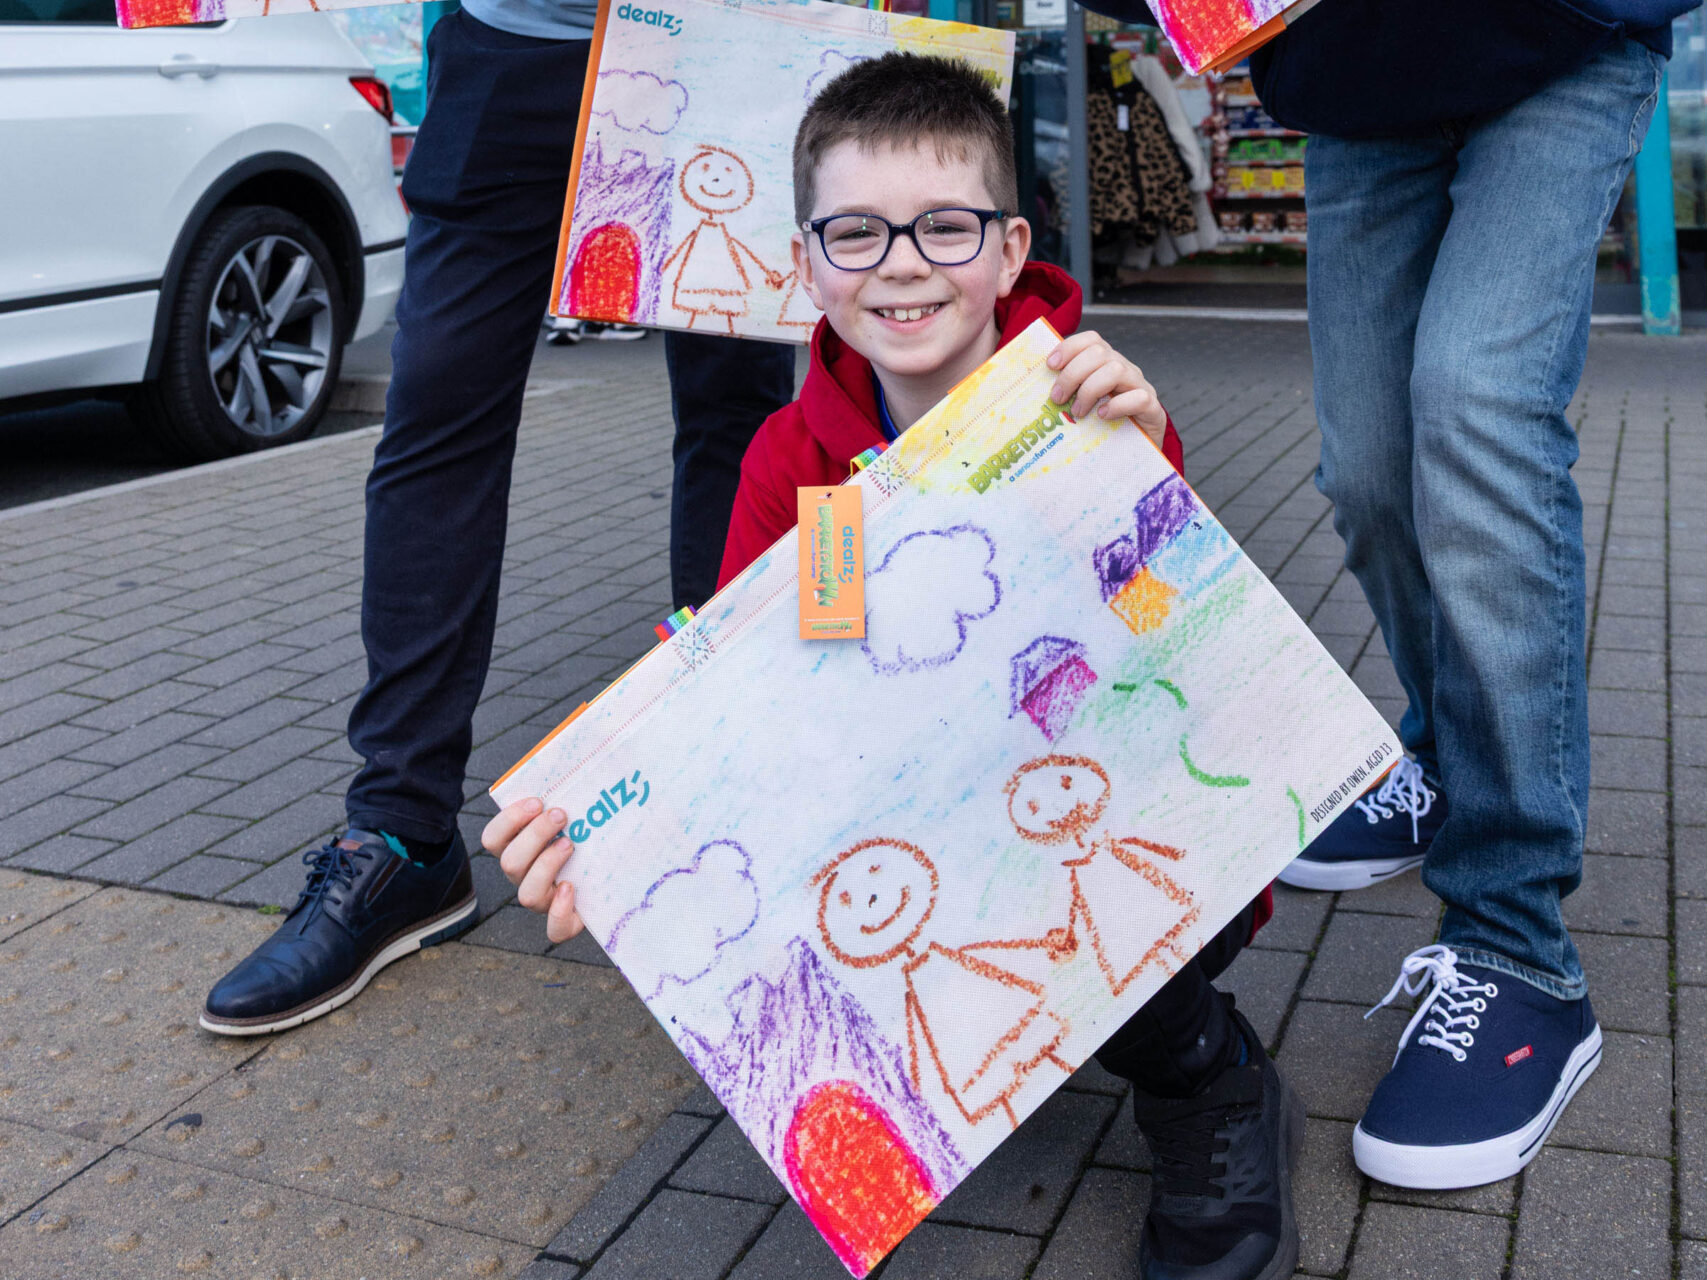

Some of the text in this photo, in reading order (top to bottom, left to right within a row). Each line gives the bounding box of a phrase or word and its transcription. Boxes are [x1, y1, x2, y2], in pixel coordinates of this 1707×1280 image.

[617, 3, 676, 30] dealz
[967, 393, 1077, 495] BARRETSTOW
[1009, 475, 1015, 483] a
[1046, 432, 1065, 451] camp
[841, 526, 856, 575] dealz
[558, 777, 638, 844] ealz
[1310, 790, 1343, 823] DESIGNED
[1339, 782, 1351, 796] BY
[1365, 749, 1384, 771] AGED
[1380, 742, 1393, 756] 13
